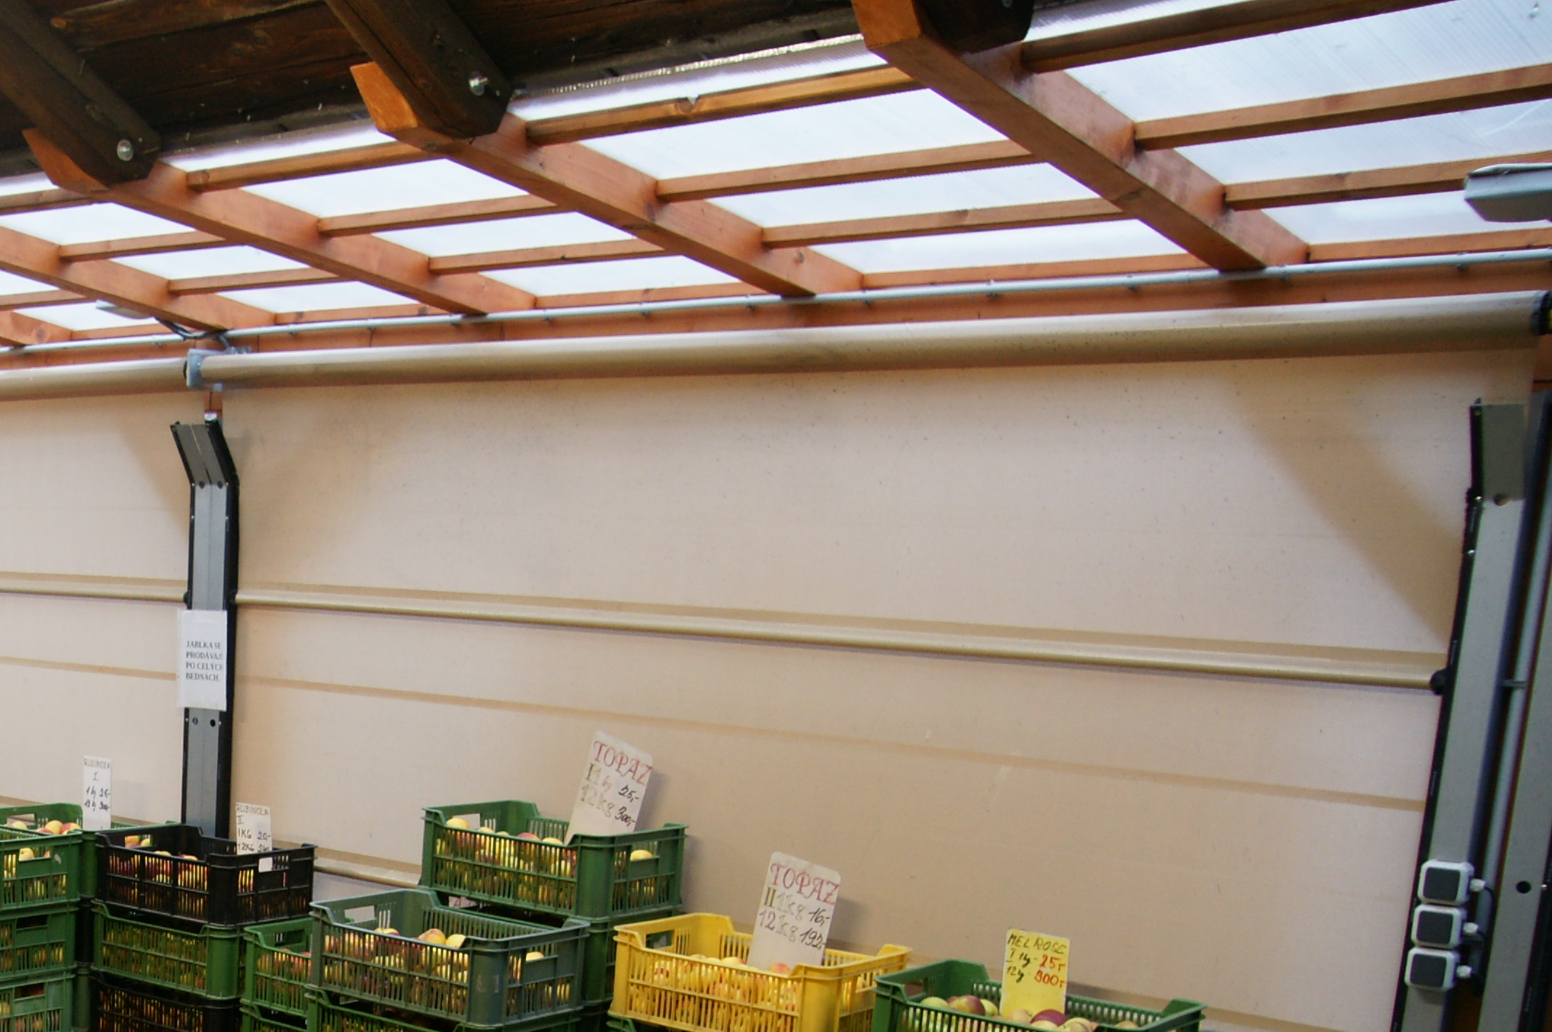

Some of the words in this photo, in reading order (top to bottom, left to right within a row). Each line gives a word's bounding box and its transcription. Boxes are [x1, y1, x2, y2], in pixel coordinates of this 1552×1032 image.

[186, 641, 213, 649] JABLKA
[593, 740, 653, 786] TOPAZ
[770, 863, 839, 905] TOPAZ
